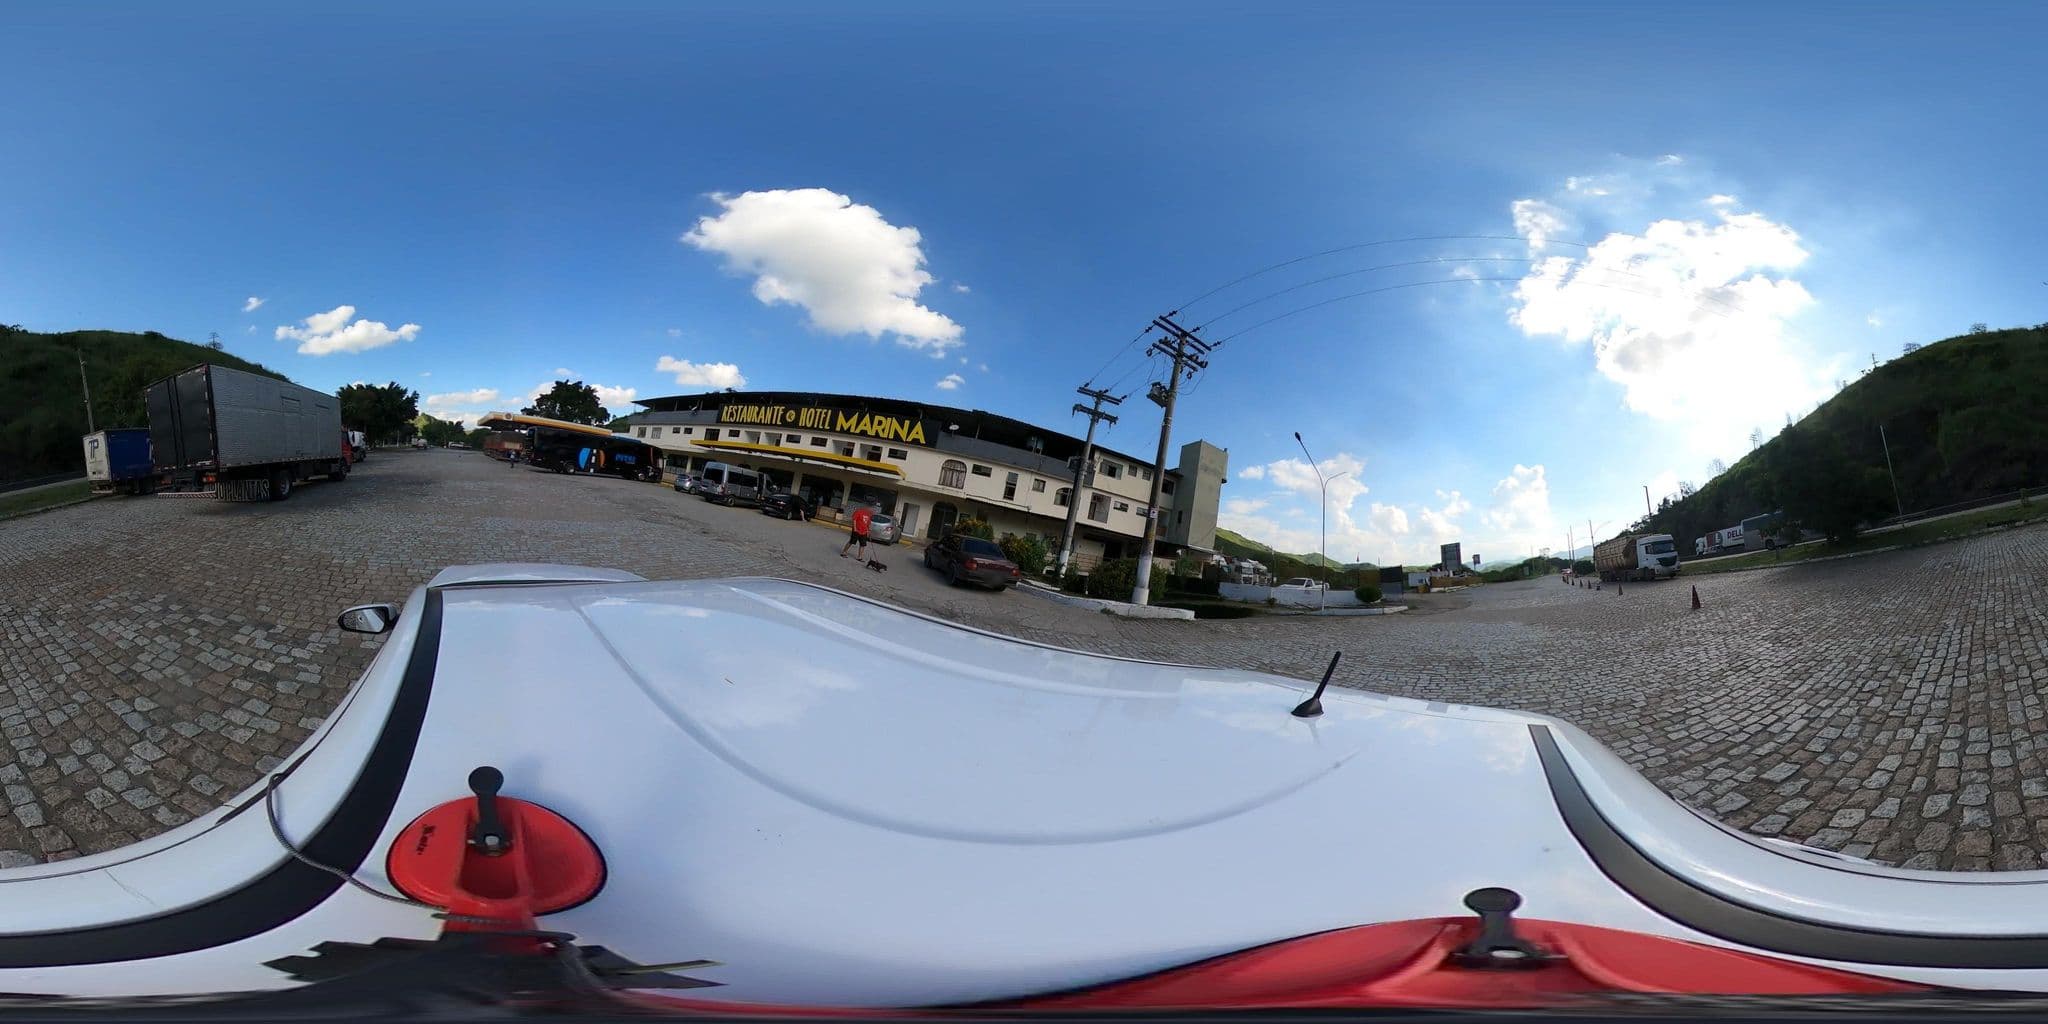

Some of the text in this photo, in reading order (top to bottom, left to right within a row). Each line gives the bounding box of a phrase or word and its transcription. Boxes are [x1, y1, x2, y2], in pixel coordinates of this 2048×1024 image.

[721, 405, 785, 424] RESTAURANTE
[798, 407, 832, 430] HOTEL
[835, 410, 926, 444] MARINA
